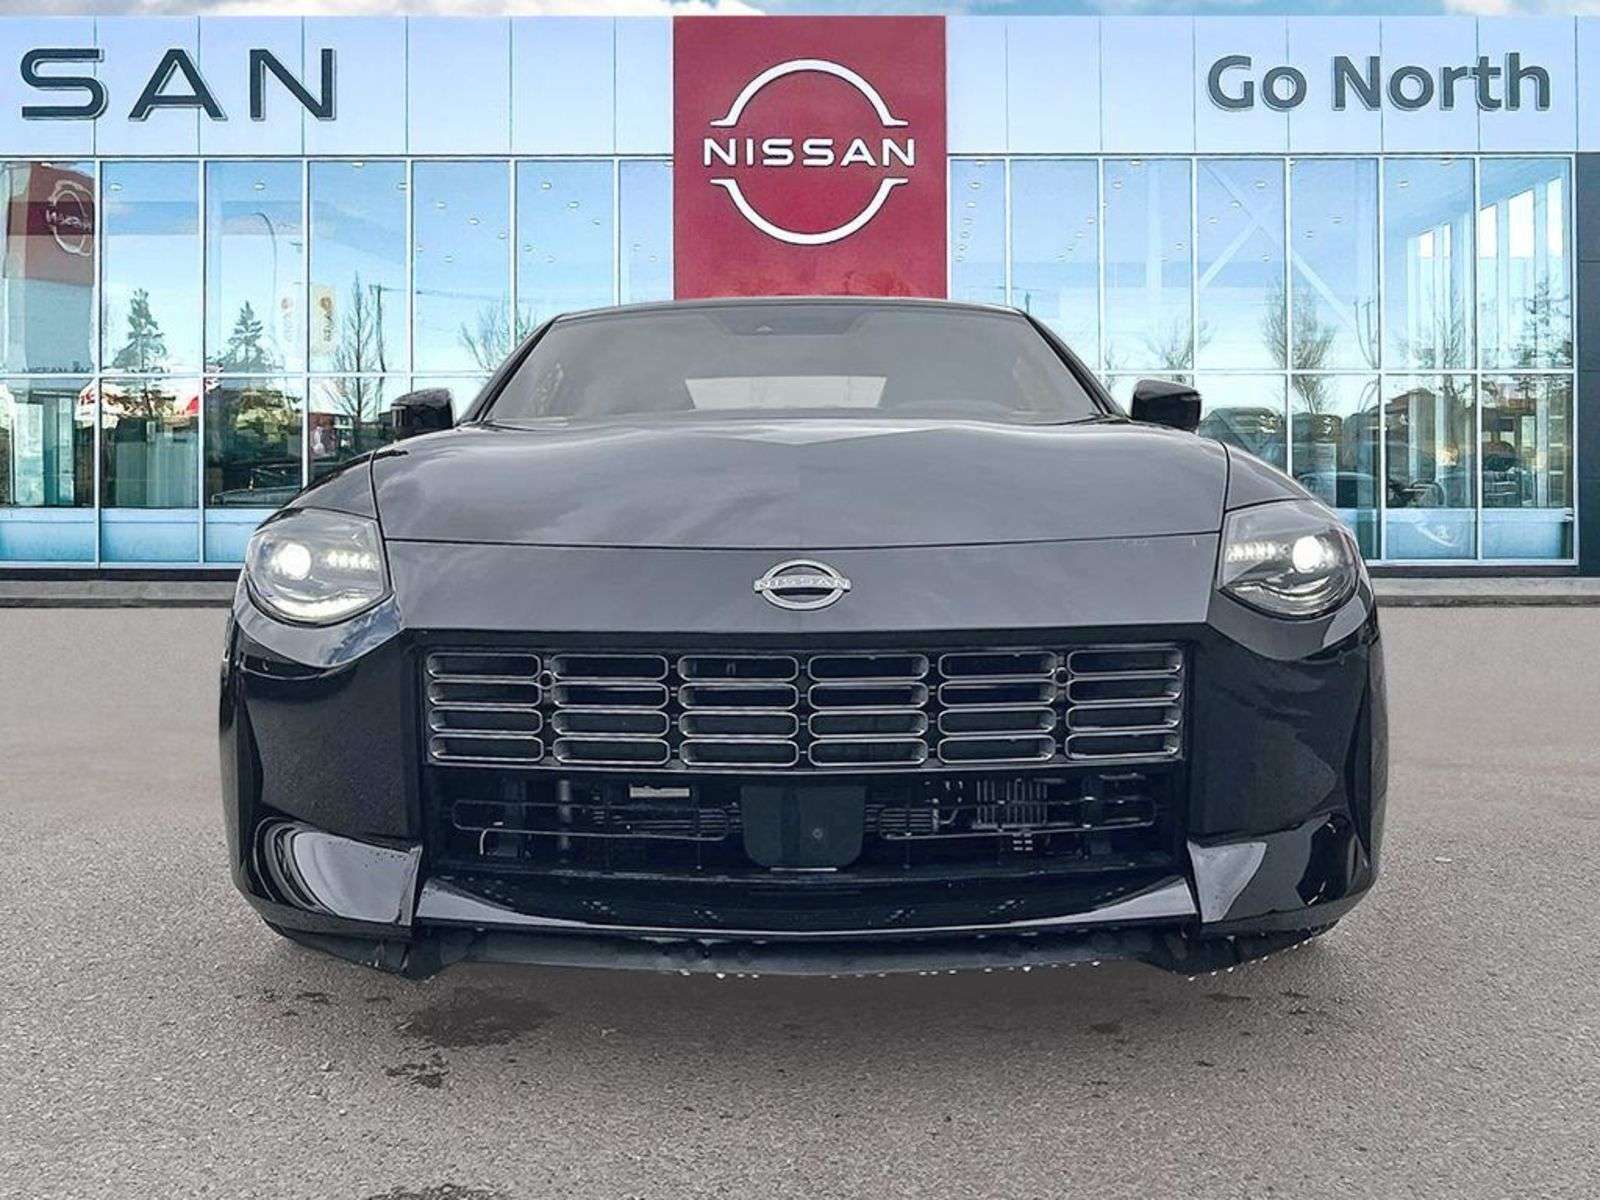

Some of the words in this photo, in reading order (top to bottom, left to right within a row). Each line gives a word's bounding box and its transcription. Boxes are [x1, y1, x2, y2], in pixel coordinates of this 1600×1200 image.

[20, 48, 336, 121] SAN
[1207, 54, 1307, 110] Go
[1332, 52, 1552, 111] North
[703, 138, 915, 167] NISSAN
